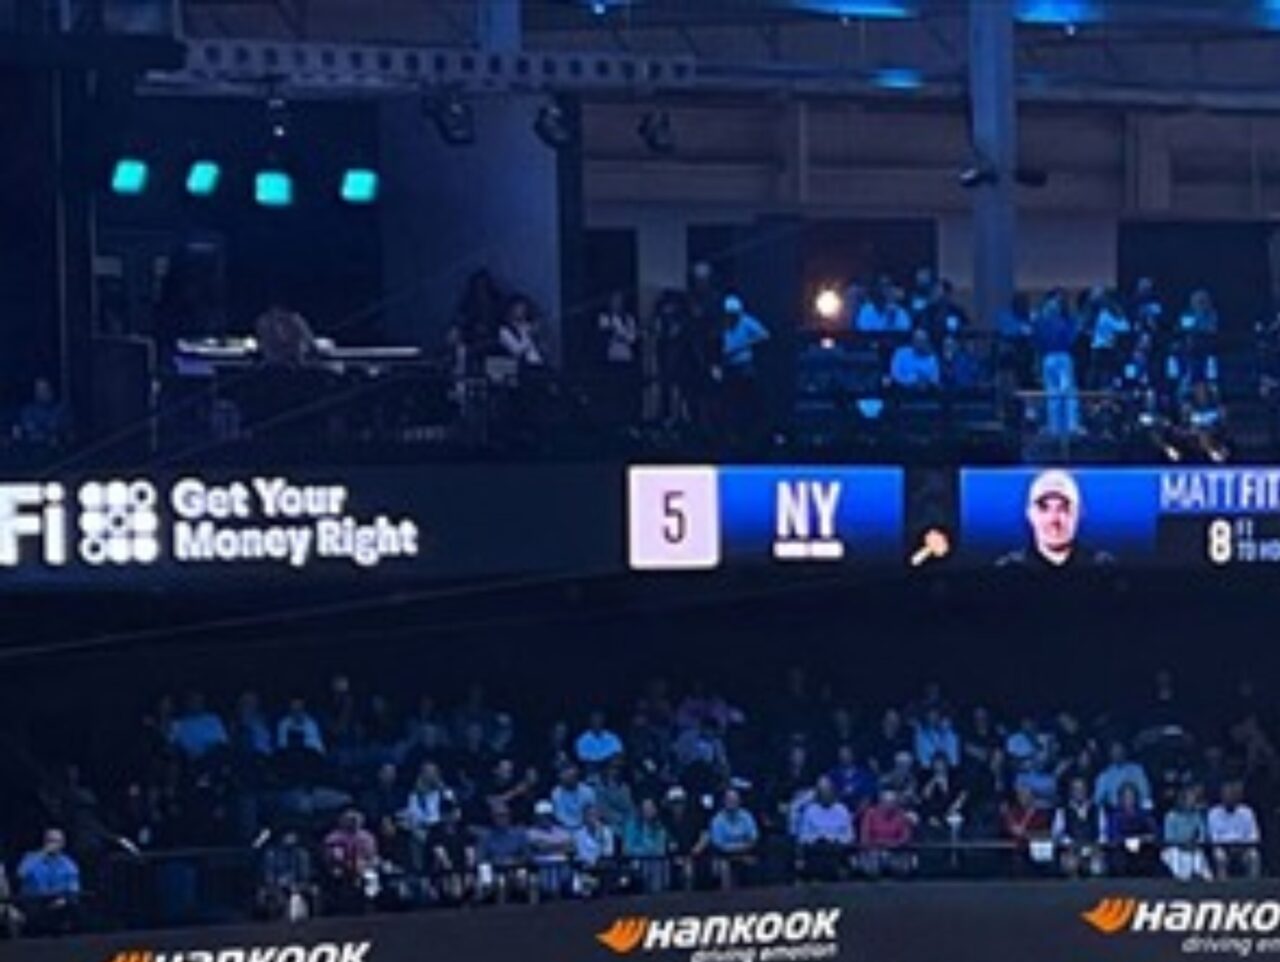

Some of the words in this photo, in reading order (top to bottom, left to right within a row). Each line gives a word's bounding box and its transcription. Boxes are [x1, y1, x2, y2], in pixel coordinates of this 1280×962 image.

[172, 480, 248, 516] Get
[254, 478, 346, 516] Your
[776, 481, 841, 537] NY
[1160, 472, 1236, 509] MATT
[663, 491, 686, 544] 5
[172, 522, 309, 565] Money
[318, 518, 418, 565] Right
[1208, 518, 1232, 563] 8
[1181, 936, 1251, 956] driving
